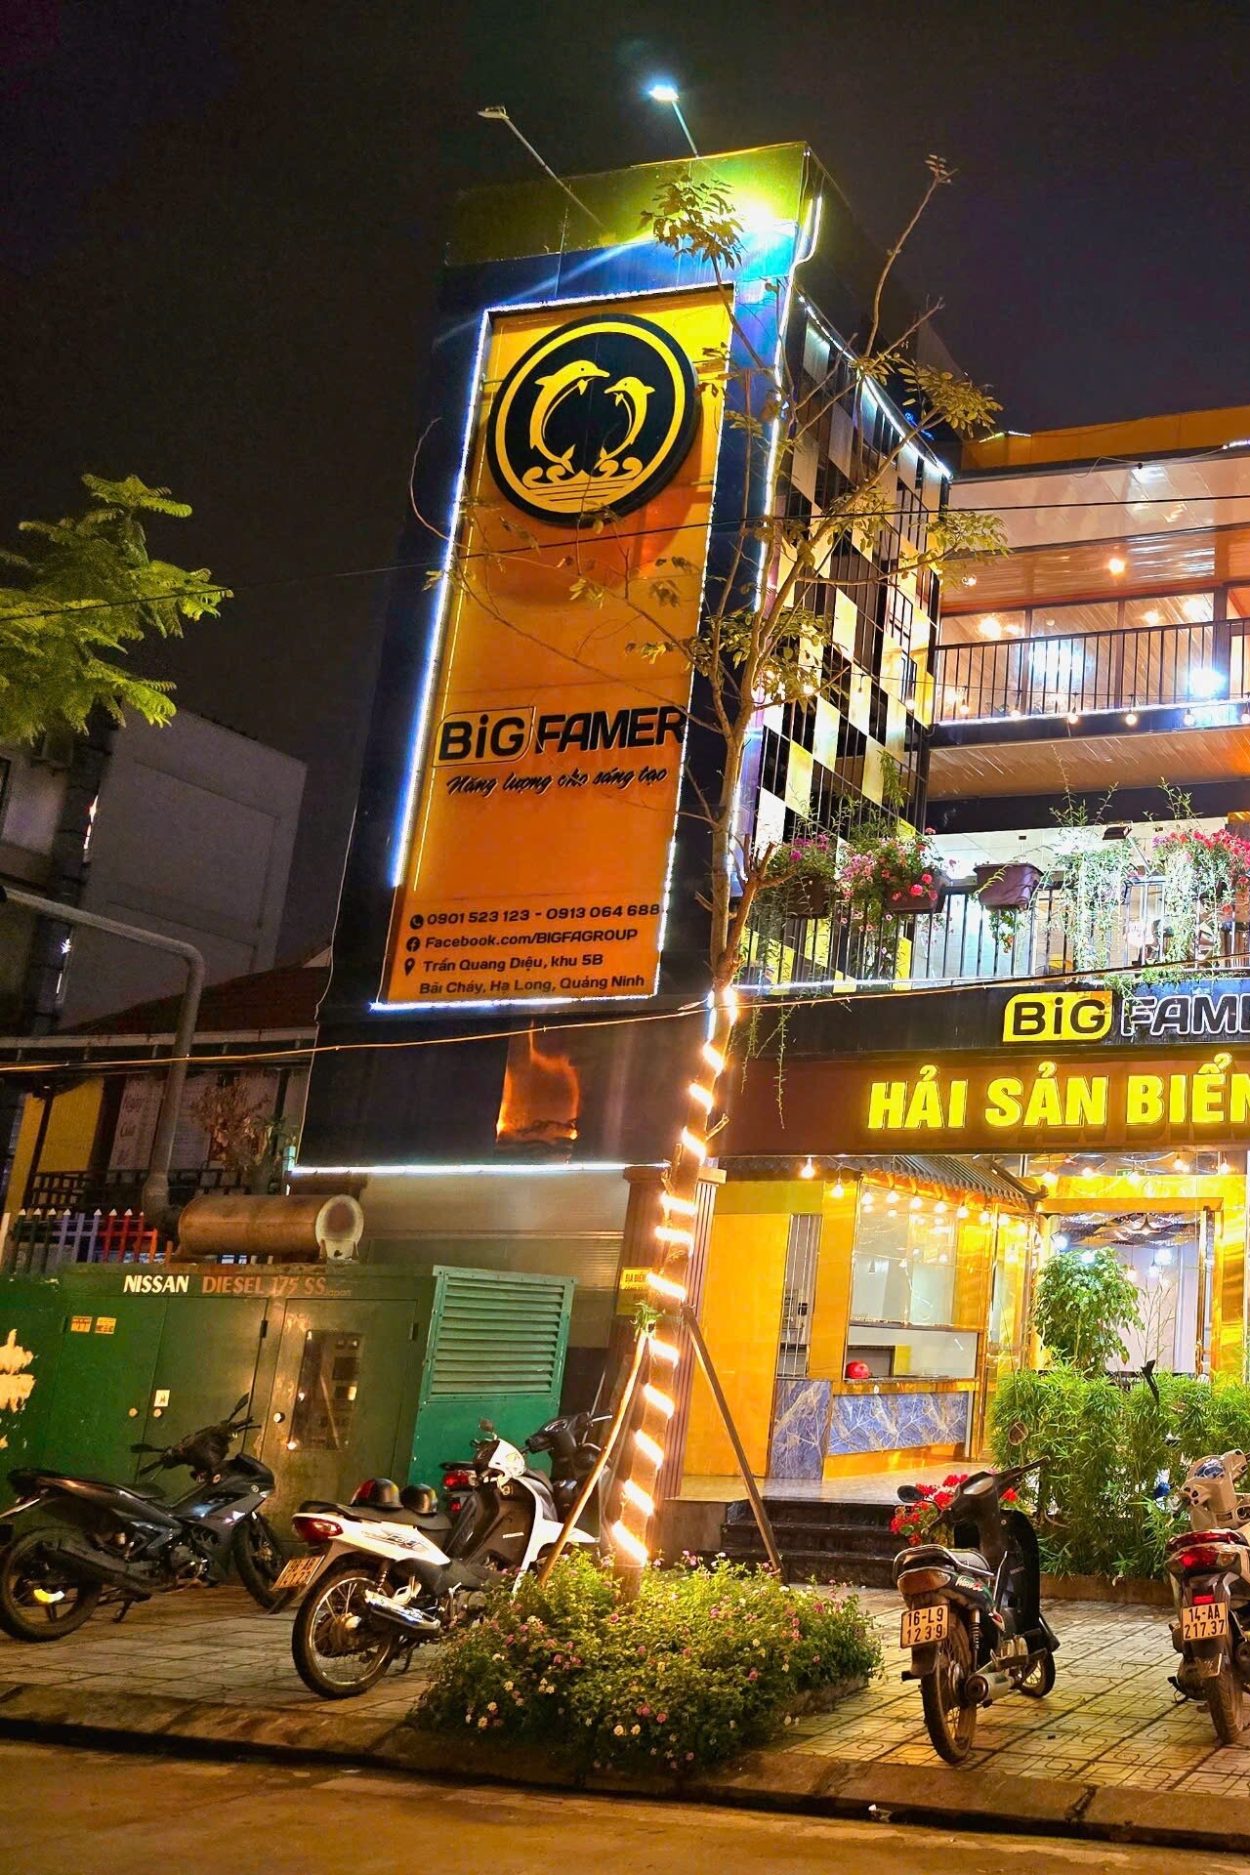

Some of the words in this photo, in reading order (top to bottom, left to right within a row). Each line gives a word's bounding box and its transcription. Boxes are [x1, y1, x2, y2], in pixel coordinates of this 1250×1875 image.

[535, 706, 690, 754] FAMER
[558, 768, 589, 788] cho
[427, 913, 464, 925] 0901
[468, 911, 499, 923] 523
[503, 909, 530, 922] 123
[546, 907, 586, 920] 0913
[590, 906, 623, 918] 064
[627, 904, 660, 917] 688
[426, 928, 638, 949] Facebook.com/BIGFAGROUP
[459, 958, 506, 973] Quang
[551, 956, 577, 967] khu
[582, 954, 604, 966] 5B
[611, 975, 645, 988] Ninh
[868, 1064, 968, 1129] HẢI
[985, 1061, 1108, 1127] SẢN
[123, 1275, 189, 1293] NISSAN
[202, 1276, 264, 1294] DIESEL
[304, 1277, 326, 1295] SS
[1188, 1605, 1220, 1622] 14-AA
[1184, 1619, 1225, 1639] 217.37
